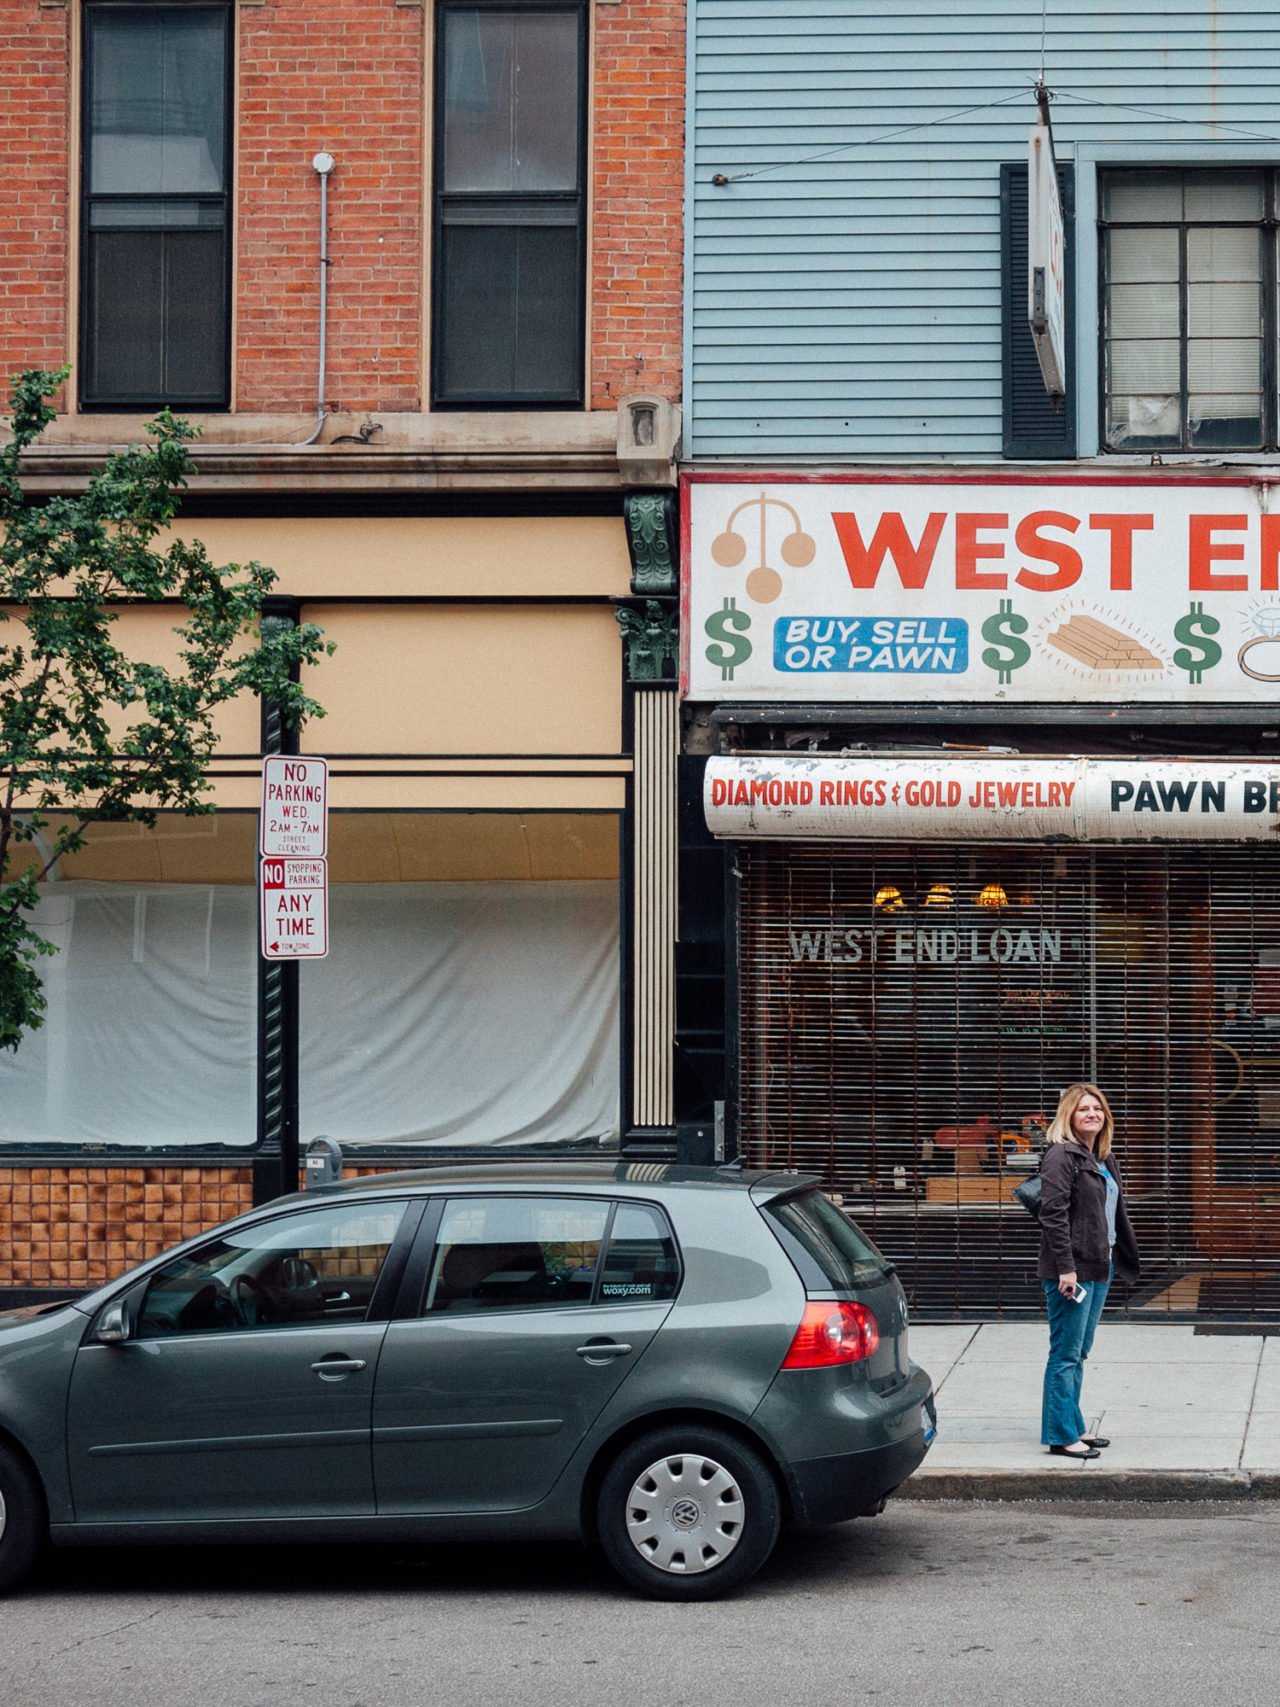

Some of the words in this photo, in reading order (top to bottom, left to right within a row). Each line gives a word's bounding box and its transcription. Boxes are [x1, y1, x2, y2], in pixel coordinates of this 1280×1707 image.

[831, 510, 1154, 592] WEST
[785, 619, 861, 645] BUY,
[871, 620, 956, 644] SELL
[785, 645, 836, 669] OR
[847, 646, 956, 670] PAWN
[284, 763, 307, 782] NO
[268, 783, 322, 803] PARKING
[711, 778, 814, 807] DIAMOND
[819, 779, 887, 807] RINGS
[904, 780, 962, 808] GOLD
[968, 780, 1076, 809] JEWELRY
[1111, 780, 1226, 813] PAWN
[282, 805, 310, 819] WED.
[270, 820, 291, 832] 2AM
[301, 821, 320, 834] 7AM
[277, 844, 311, 852] CLEANING
[264, 864, 284, 884] NO
[287, 863, 322, 873] STOPPING
[289, 875, 320, 885] PARKING
[277, 894, 312, 912] ANY
[276, 917, 315, 936] TIME
[790, 929, 885, 962] WEST
[894, 929, 960, 962] END
[970, 929, 1062, 962] LOAN
[603, 1287, 651, 1296] woxy.com
